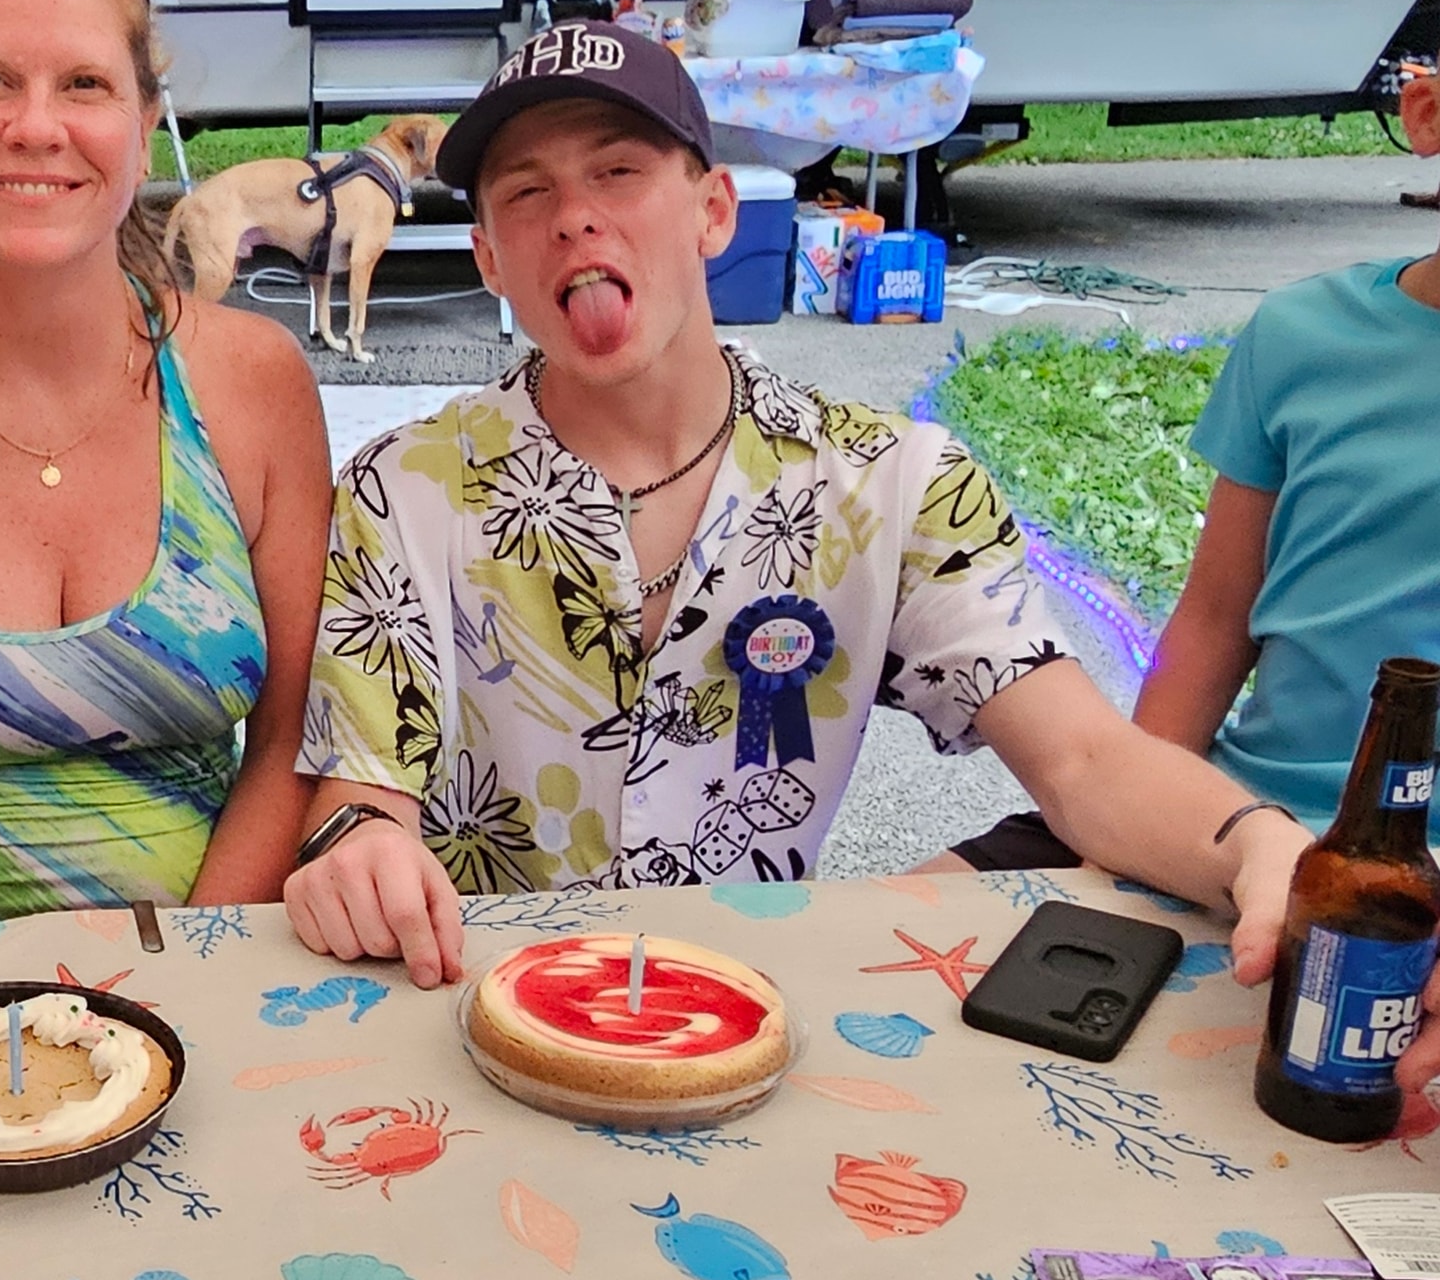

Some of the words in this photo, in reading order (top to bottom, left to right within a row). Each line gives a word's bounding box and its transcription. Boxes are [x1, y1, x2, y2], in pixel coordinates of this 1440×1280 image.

[883, 270, 921, 286] BUD
[877, 283, 926, 300] LIGHT
[749, 635, 811, 652] BIRTHDAY
[760, 651, 796, 664] BOY
